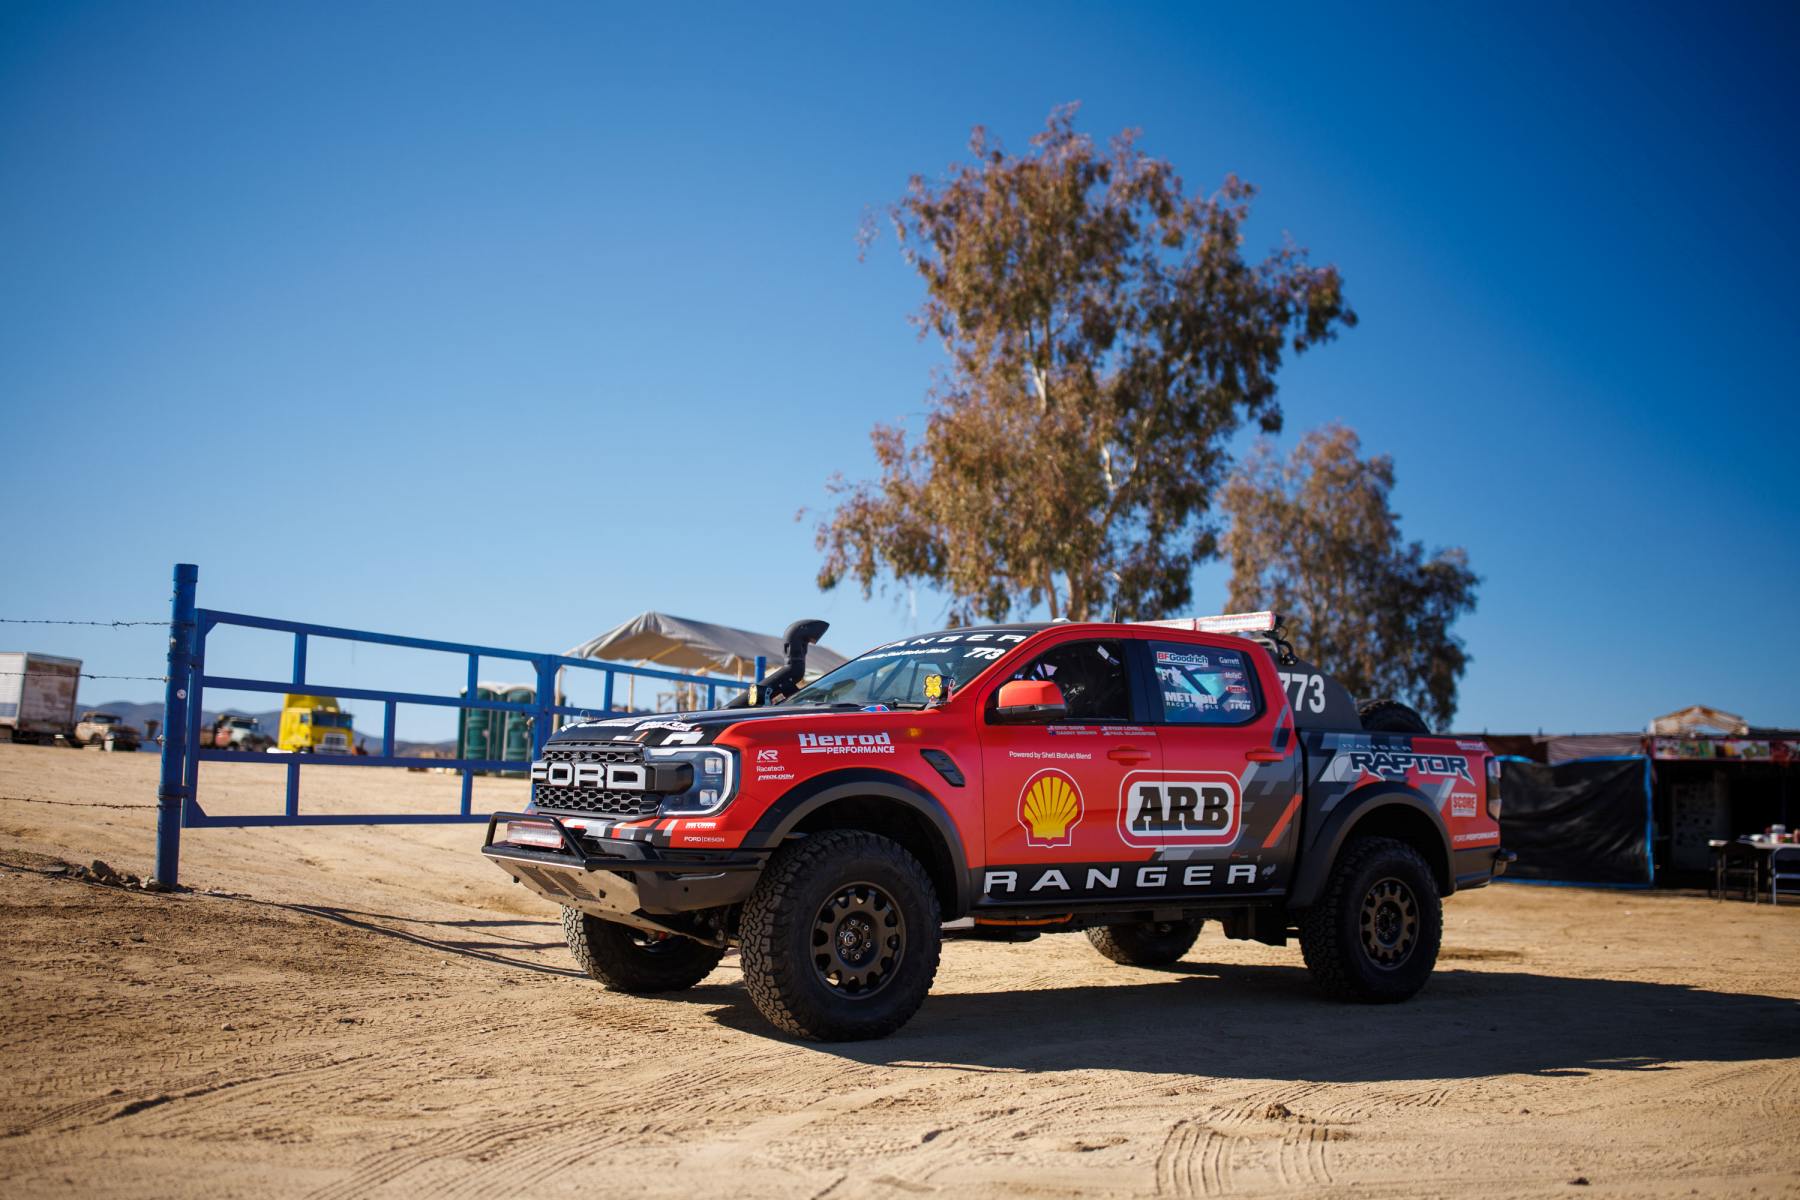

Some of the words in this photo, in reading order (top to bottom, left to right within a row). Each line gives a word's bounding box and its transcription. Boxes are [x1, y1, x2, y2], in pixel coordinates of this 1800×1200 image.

[963, 647, 1006, 660] 773
[1157, 651, 1209, 664] BFGoodrich
[1219, 657, 1240, 665] Garrett
[798, 731, 891, 747] Herrod
[826, 746, 896, 755] PERFORMANCE
[1342, 743, 1413, 752] RANGER
[757, 749, 779, 760] KR
[1034, 752, 1041, 760] by
[531, 761, 647, 790] FORD
[1349, 752, 1476, 787] RAPTOR
[1132, 786, 1230, 832] ARB
[1453, 796, 1476, 809] SCORE
[984, 864, 1258, 894] RANGER
